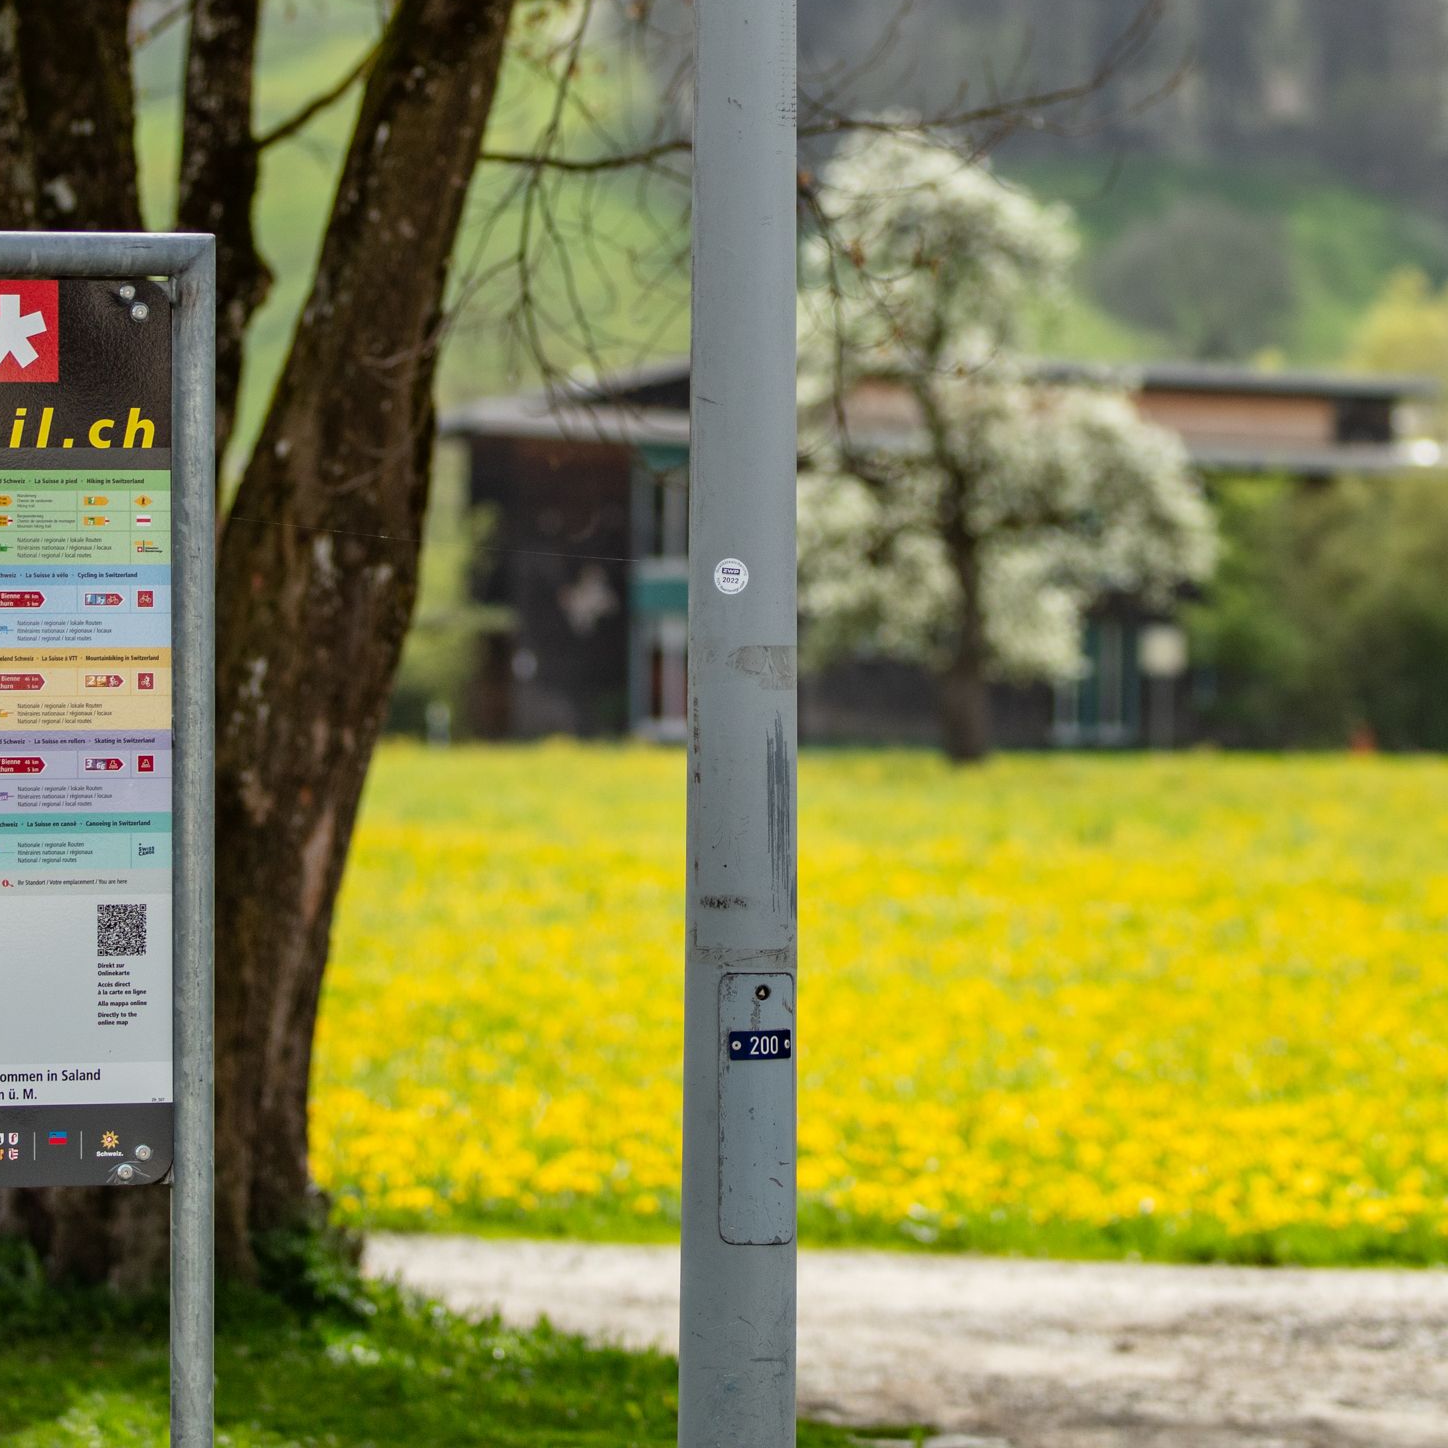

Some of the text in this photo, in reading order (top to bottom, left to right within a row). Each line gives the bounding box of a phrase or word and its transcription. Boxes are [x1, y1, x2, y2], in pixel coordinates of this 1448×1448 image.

[750, 1036, 778, 1054] 200
[48, 1070, 57, 1081] in
[62, 1069, 100, 1081] Saland
[9, 1089, 19, 1100] ü.
[23, 1088, 37, 1099] M.
